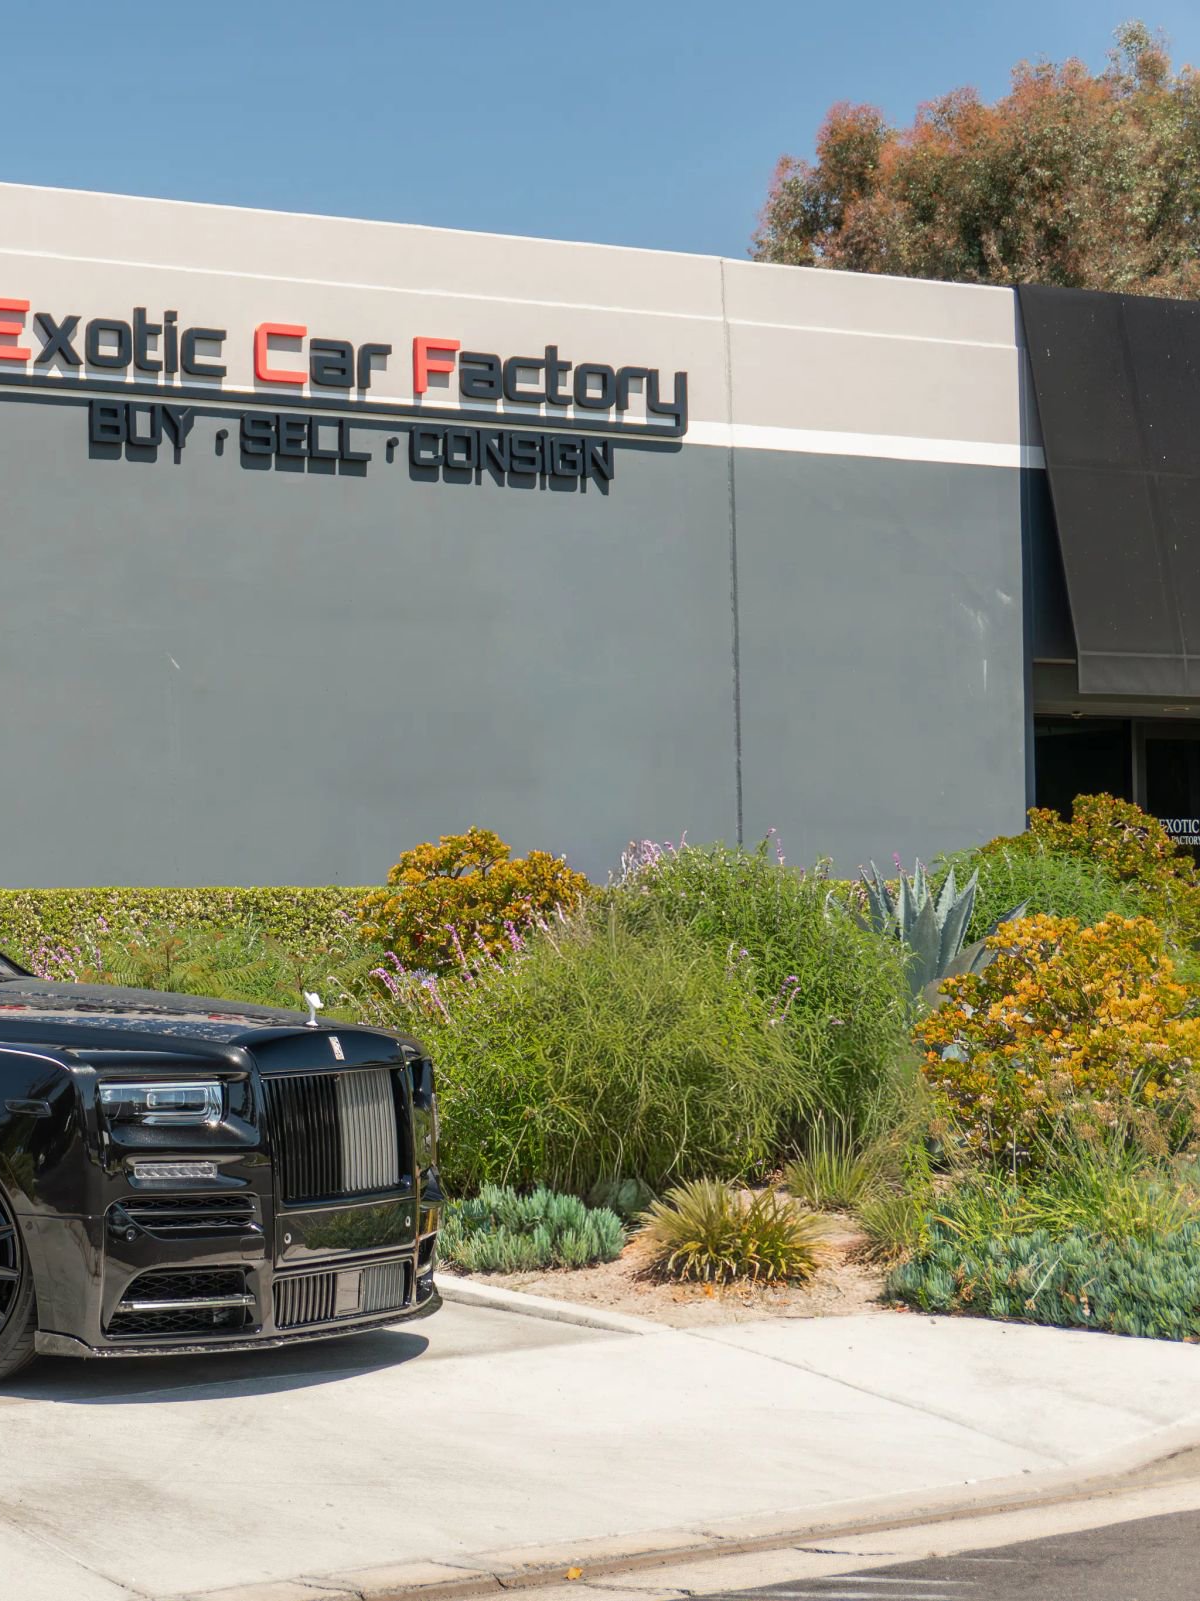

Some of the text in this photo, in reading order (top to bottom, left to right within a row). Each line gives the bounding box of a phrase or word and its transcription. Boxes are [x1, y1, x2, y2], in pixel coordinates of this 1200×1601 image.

[254, 322, 393, 389] Car
[412, 335, 689, 438] Factory
[89, 399, 614, 481] BUY SELL CONSIGN
